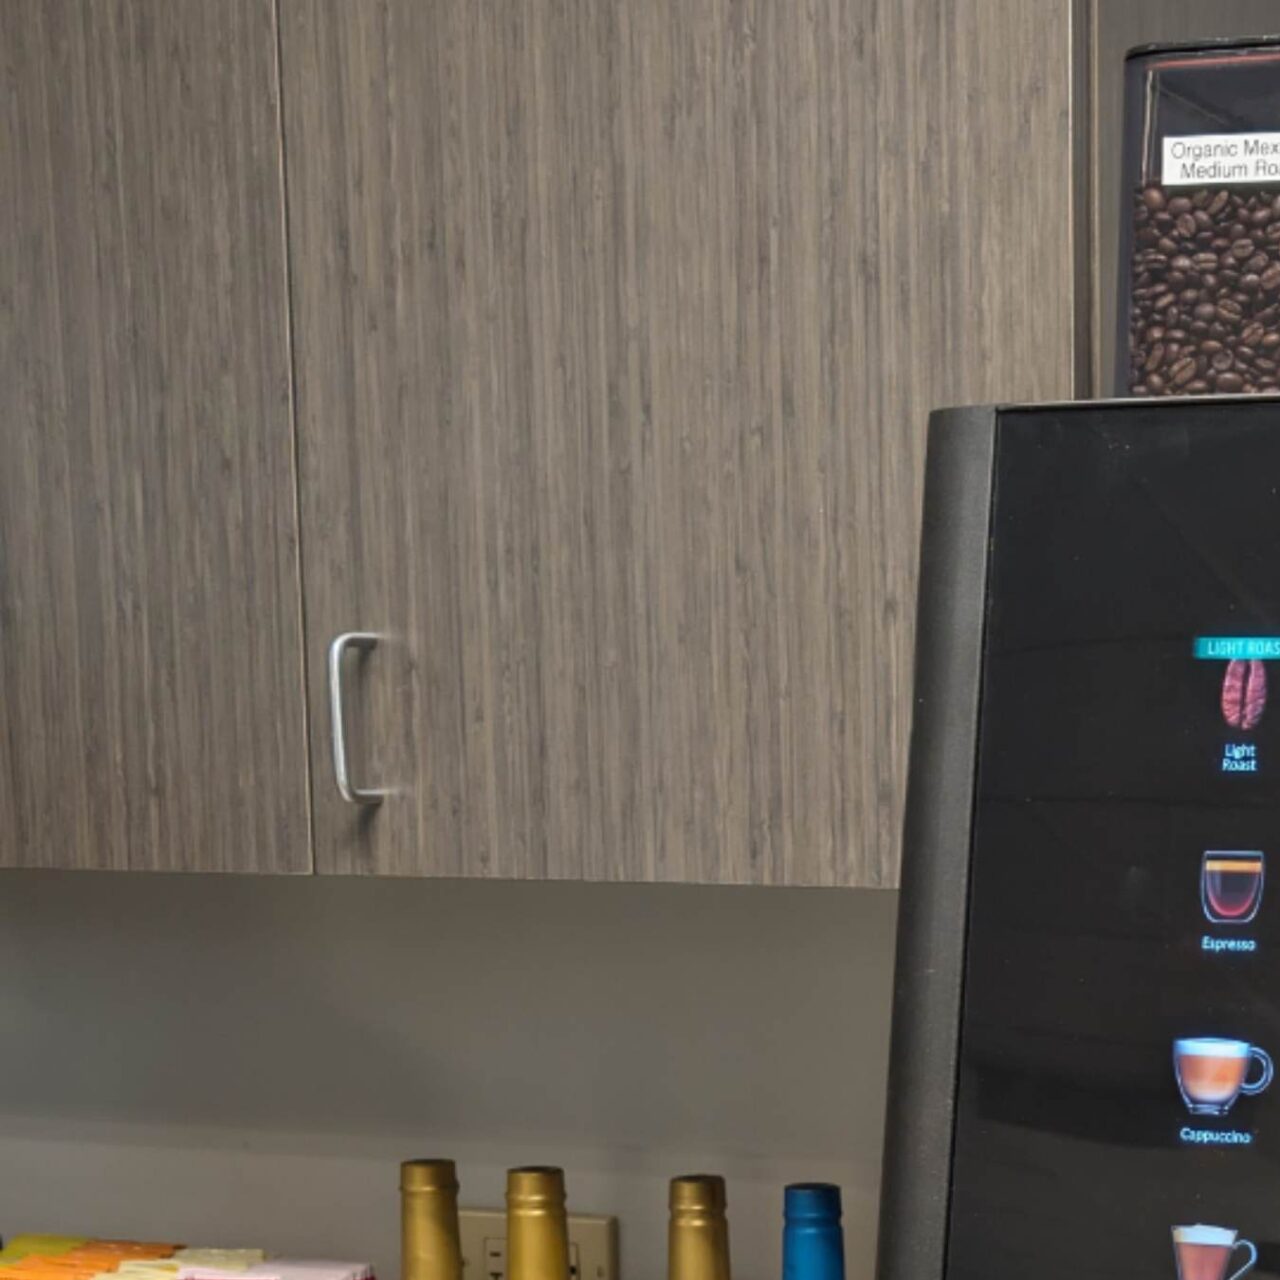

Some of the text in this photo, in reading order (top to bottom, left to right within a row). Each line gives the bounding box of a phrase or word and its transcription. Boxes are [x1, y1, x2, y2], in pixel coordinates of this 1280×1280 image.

[1170, 139, 1239, 161] Organic
[1180, 160, 1249, 179] Medium
[1207, 641, 1245, 655] LIGHT
[1224, 743, 1258, 760] Light
[1221, 757, 1258, 773] Roast
[1201, 936, 1256, 953] Espresso
[1179, 1126, 1252, 1144] Cappuccino
